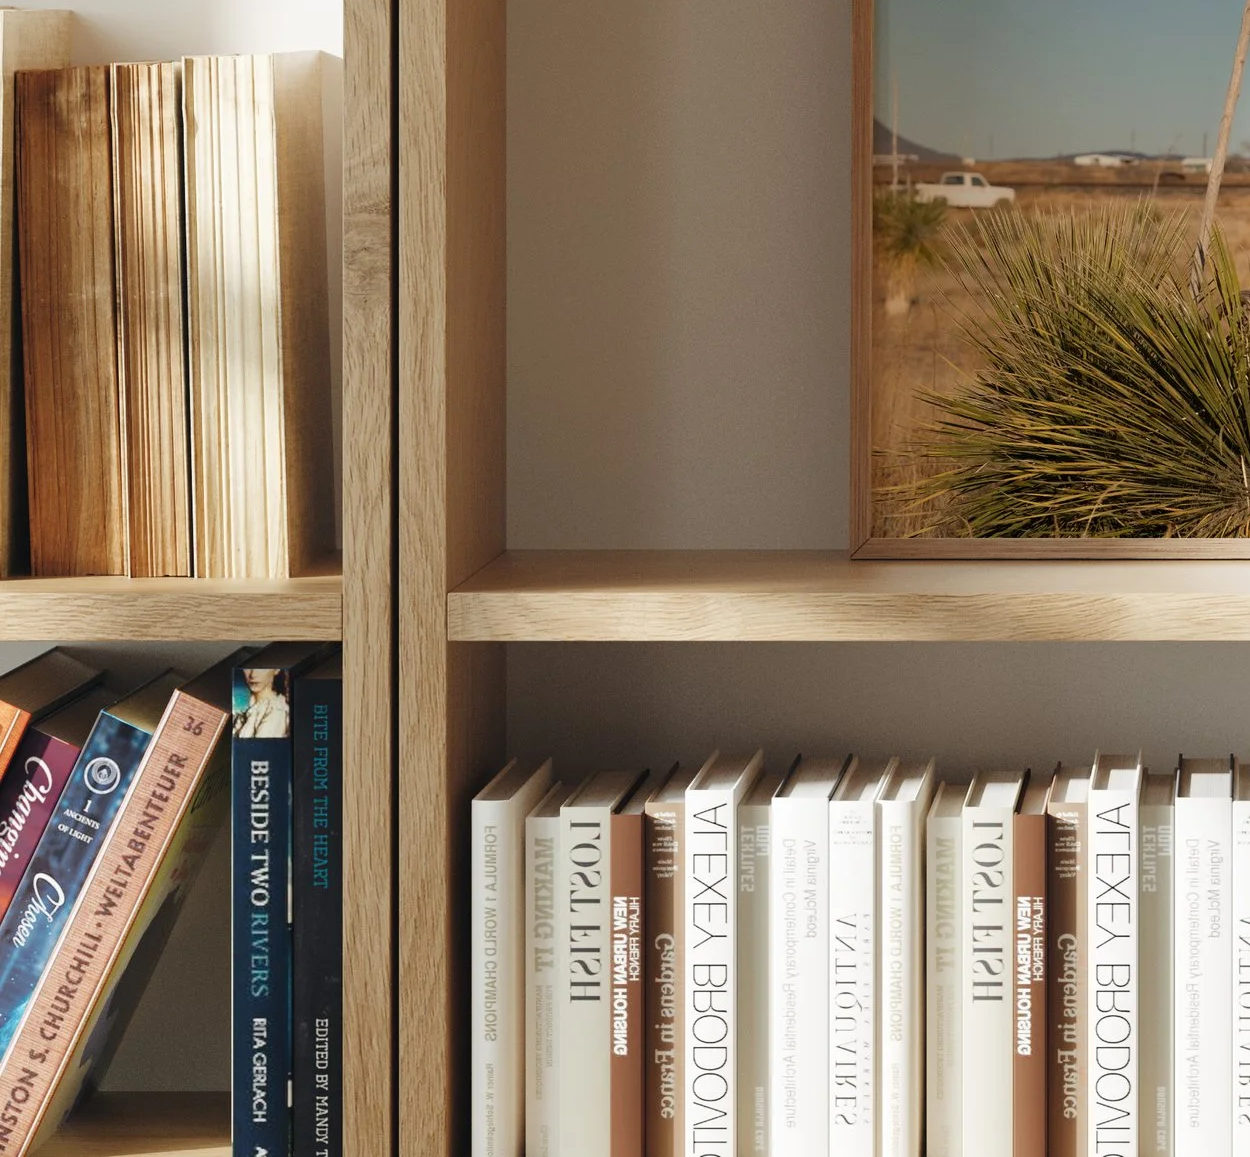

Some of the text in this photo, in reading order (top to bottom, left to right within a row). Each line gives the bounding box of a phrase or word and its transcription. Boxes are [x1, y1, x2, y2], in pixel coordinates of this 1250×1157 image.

[58, 823, 94, 845] OF LIGHT
[63, 809, 100, 830] ANCIENTS
[314, 704, 328, 890] BITE FROM THE HEART
[13, 872, 65, 949] Chosen
[250, 761, 269, 998] BESIDE TWO RIVERS
[0, 754, 188, 1152] NSTON S. CHURCHILL WELTABENTEUER
[252, 1018, 266, 1123] RITA GERLACH
[316, 1018, 328, 1146] EDITED BY MANDY
